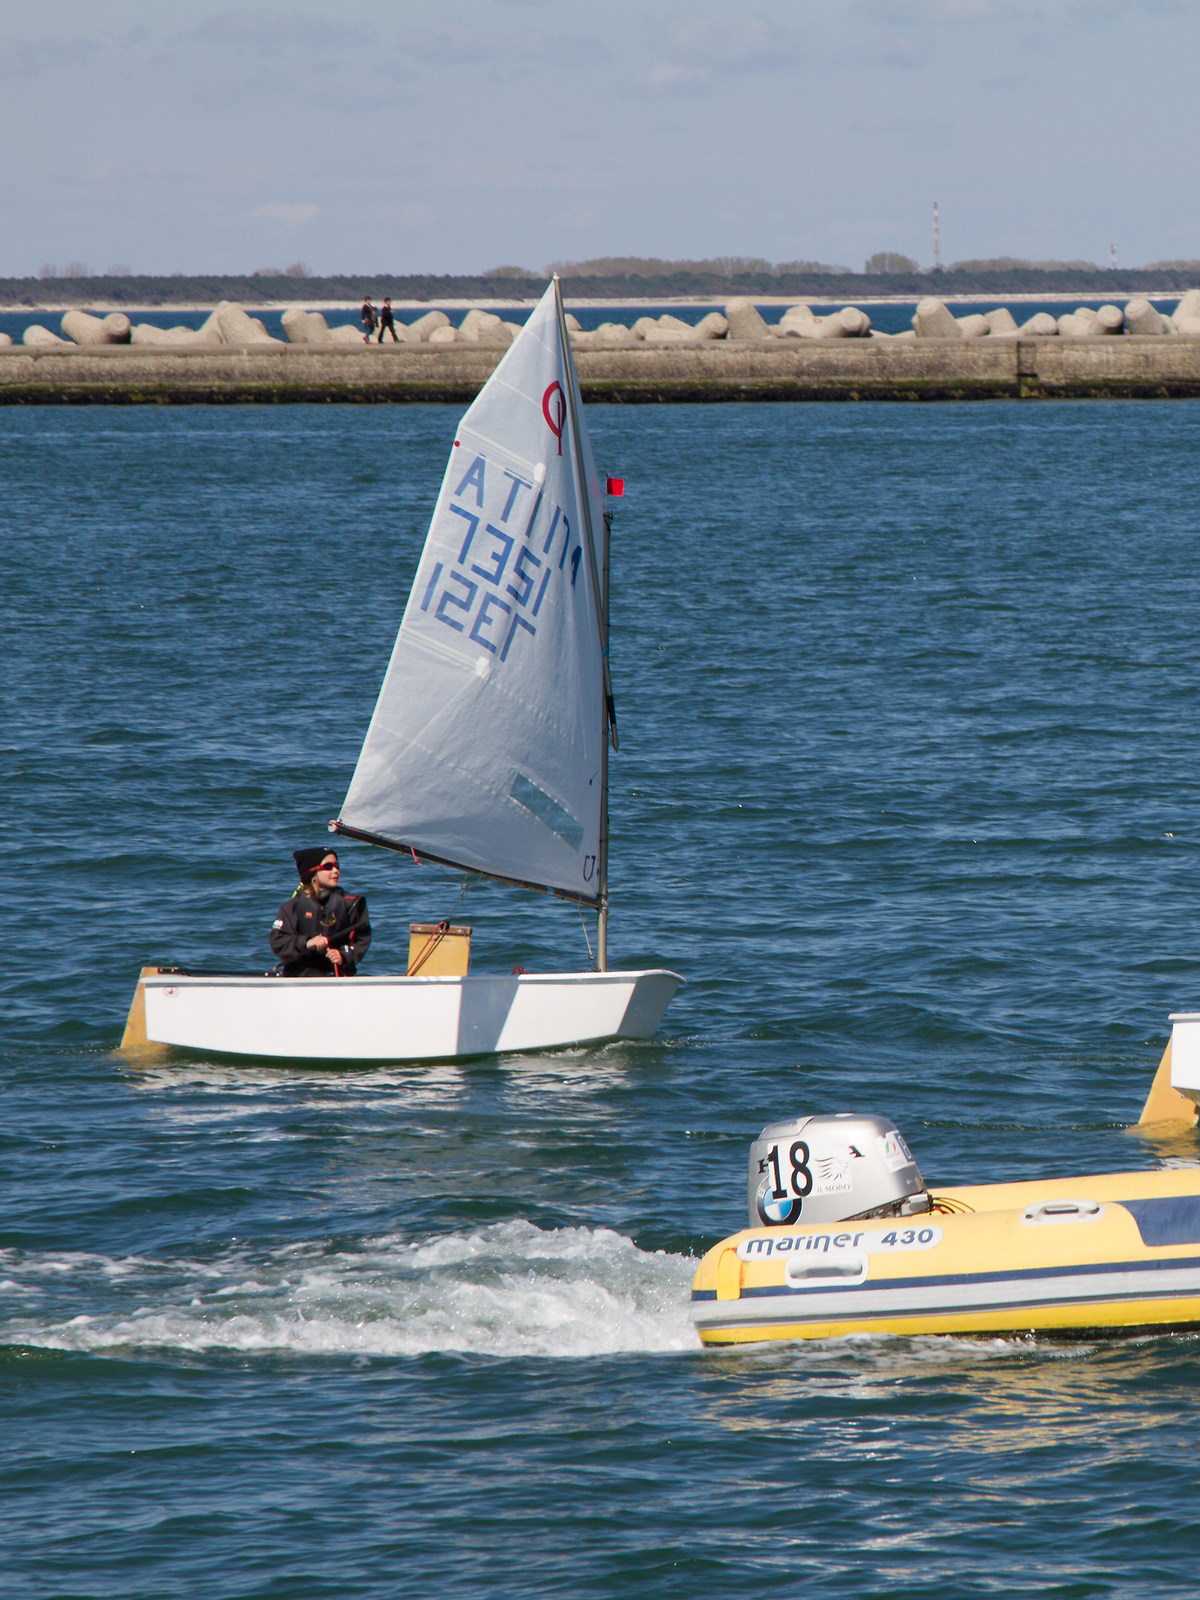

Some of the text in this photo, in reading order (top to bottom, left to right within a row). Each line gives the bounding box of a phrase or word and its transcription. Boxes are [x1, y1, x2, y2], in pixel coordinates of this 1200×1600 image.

[767, 1141, 813, 1199] 18
[746, 1229, 934, 1255] mariner 430
